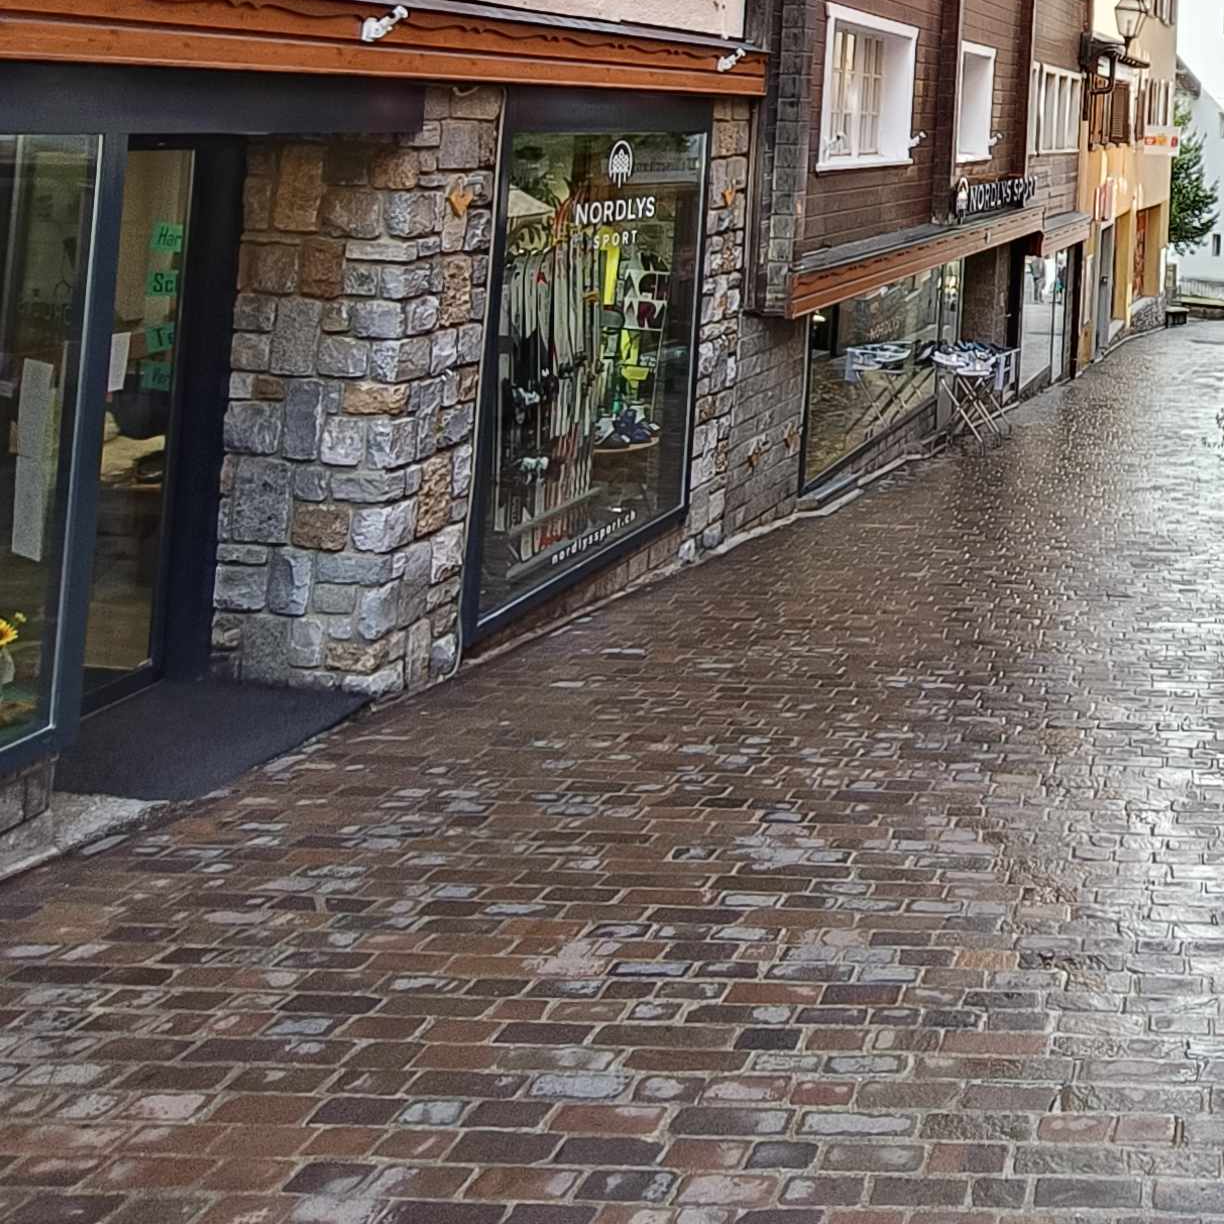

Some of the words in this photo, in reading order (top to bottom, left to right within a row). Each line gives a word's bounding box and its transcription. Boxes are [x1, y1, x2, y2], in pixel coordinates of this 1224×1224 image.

[575, 196, 655, 226] NORDLYS
[969, 180, 1012, 212] NORDLYS
[593, 230, 638, 249] SPORT
[552, 509, 636, 565] nordlyssport.ch
